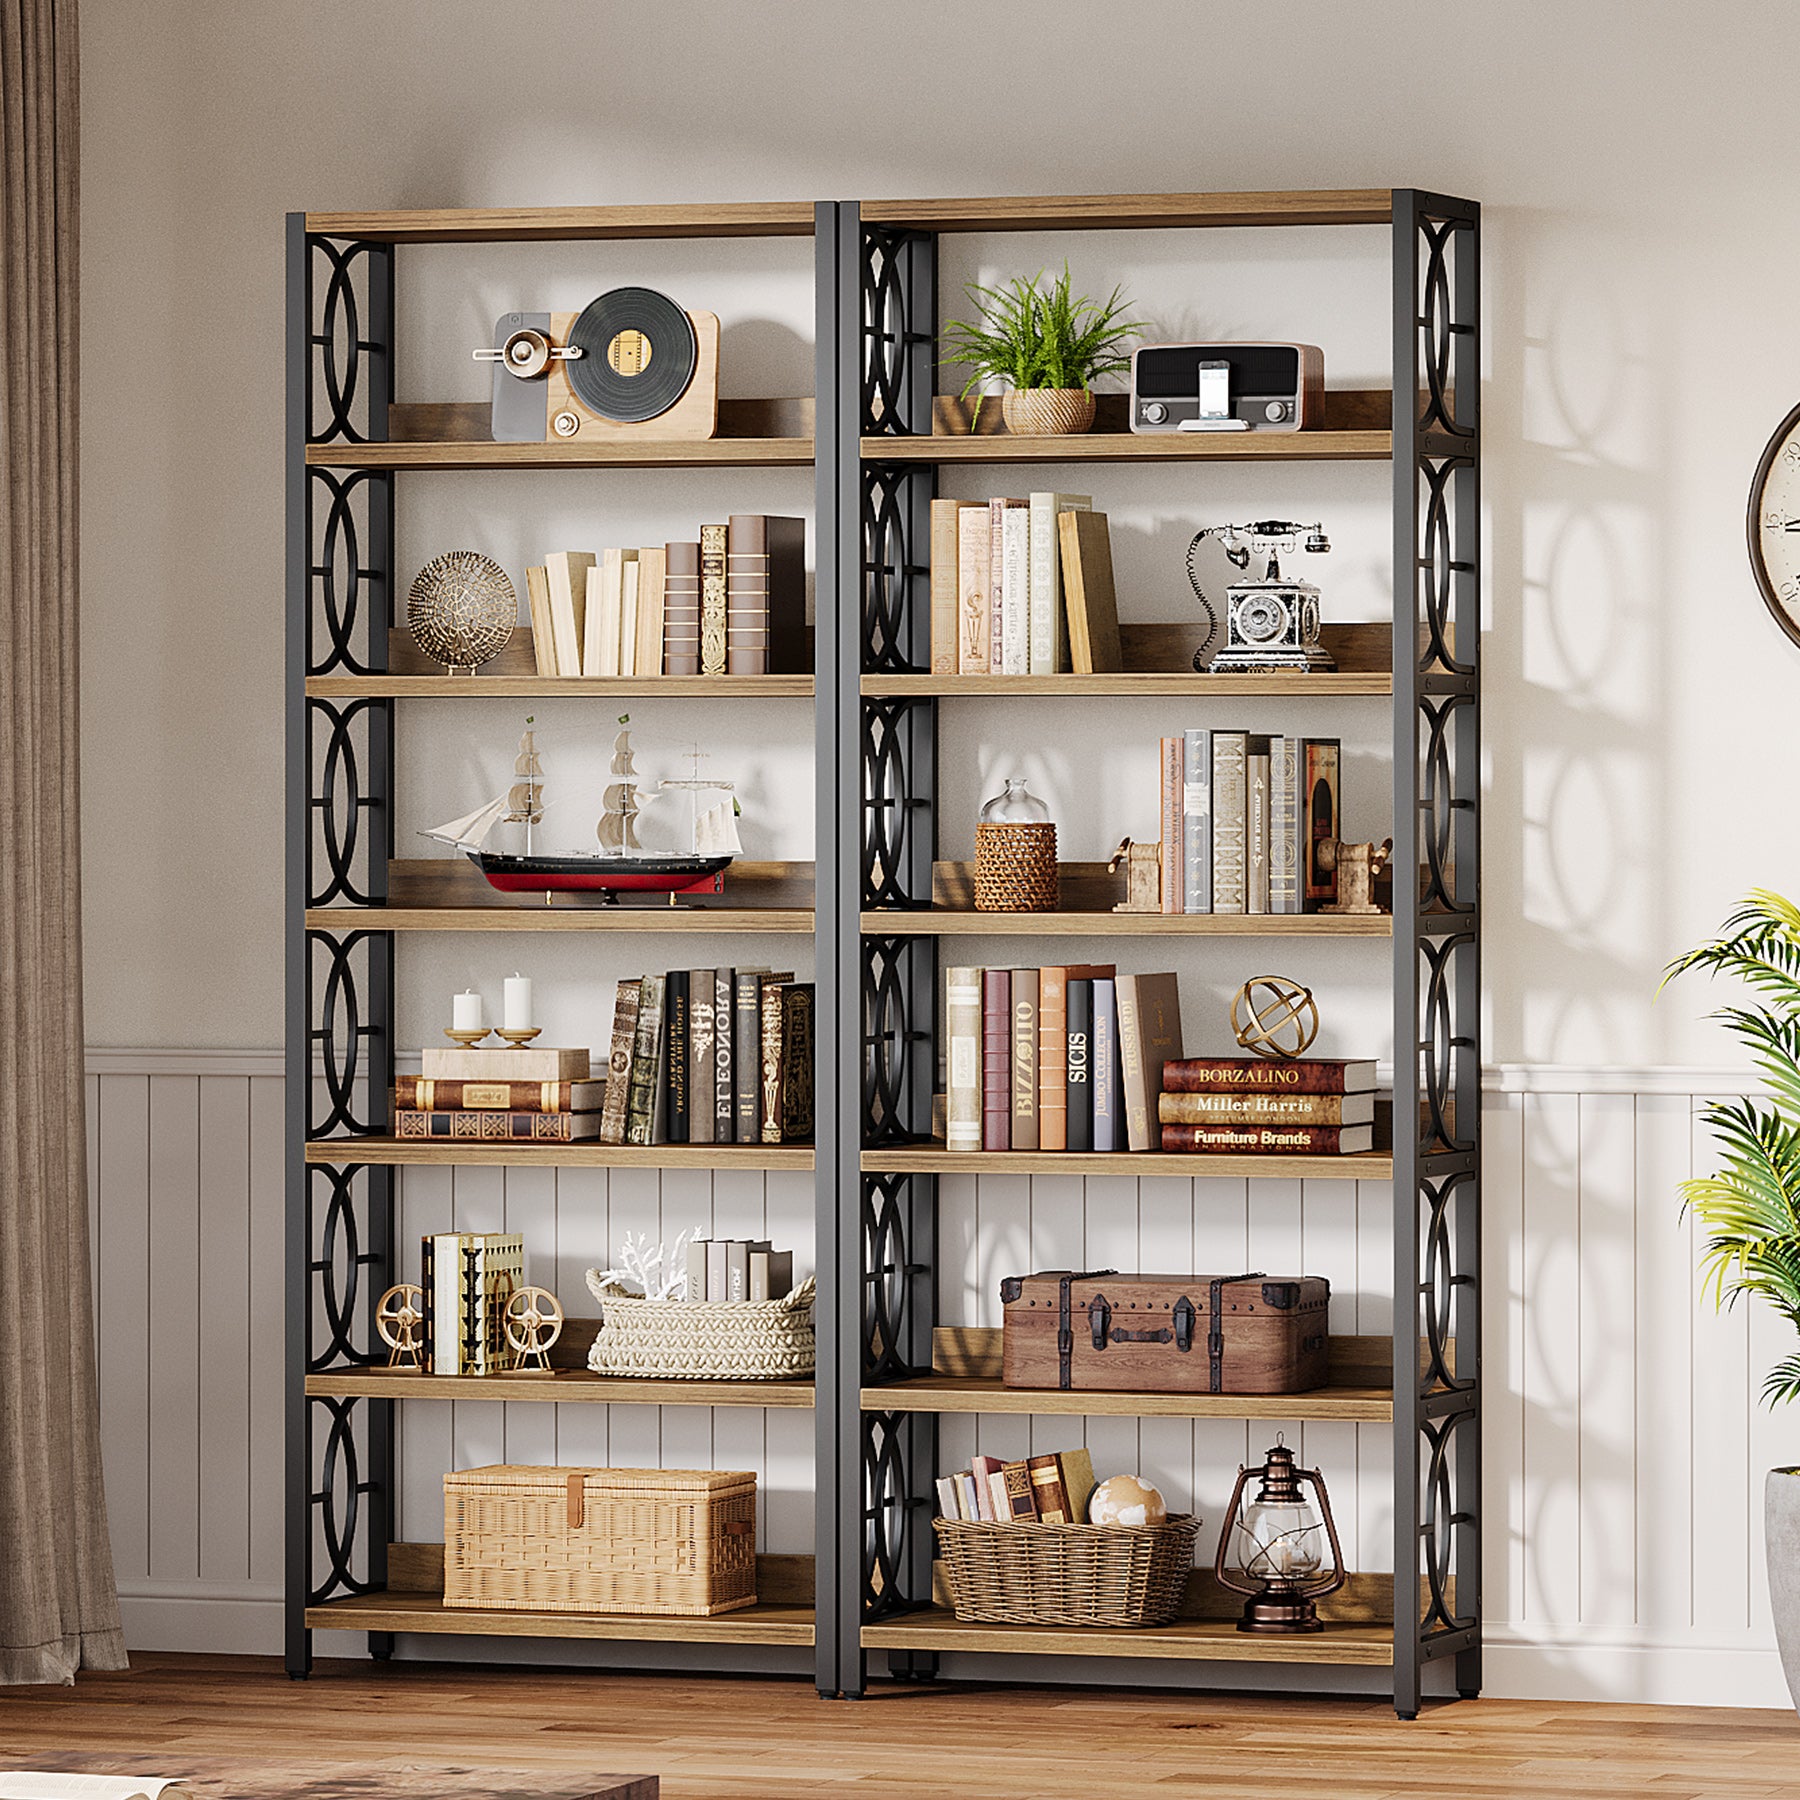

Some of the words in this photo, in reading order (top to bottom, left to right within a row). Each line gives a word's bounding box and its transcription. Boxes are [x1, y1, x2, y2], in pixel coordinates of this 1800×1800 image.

[1783, 441, 1800, 466] 50
[1765, 512, 1780, 535] 45
[1095, 1016, 1107, 1080] COLLECTION
[1122, 1000, 1139, 1078] TRUSSARDI
[1016, 1001, 1033, 1117] BIZZOTTO
[1069, 1032, 1087, 1083] SICIS
[1200, 1069, 1299, 1084] BORZALINO
[1095, 1081, 1109, 1117] JUMBO
[1197, 1097, 1251, 1112] Miller
[1255, 1098, 1313, 1113] Harris
[1194, 1130, 1258, 1145] Furniture
[1261, 1131, 1312, 1145] Brands
